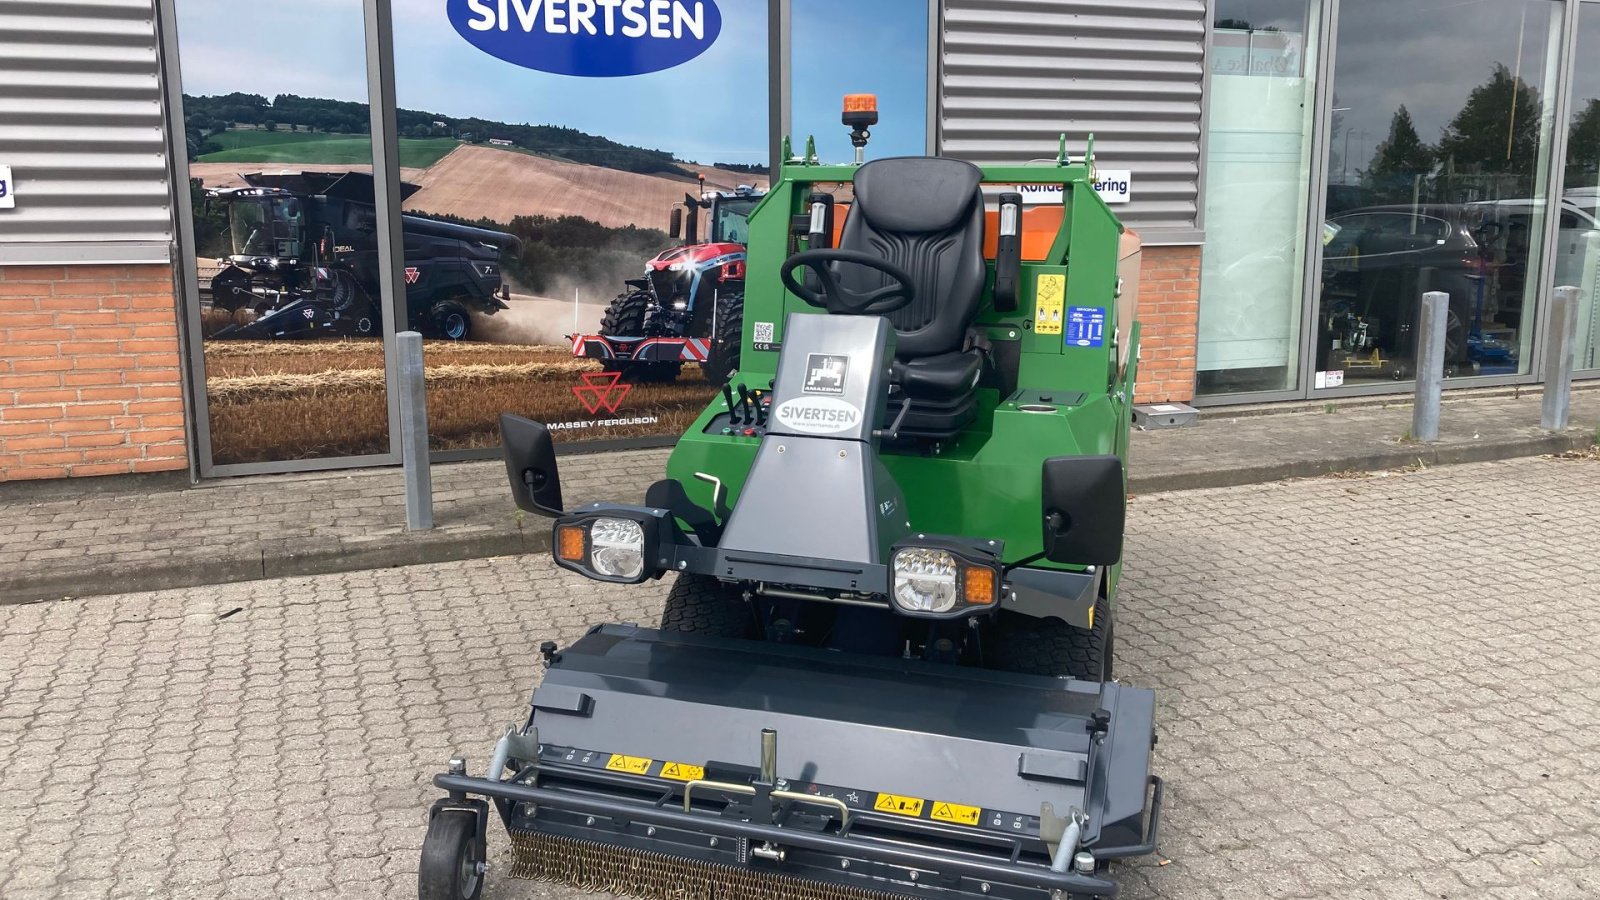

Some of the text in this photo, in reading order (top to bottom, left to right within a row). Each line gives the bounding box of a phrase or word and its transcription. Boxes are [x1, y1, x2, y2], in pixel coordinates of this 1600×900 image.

[468, 0, 704, 40] SIVERTSEN
[546, 416, 658, 430] MASSEY FERGUSON
[781, 406, 857, 423] SIVERTSEN
